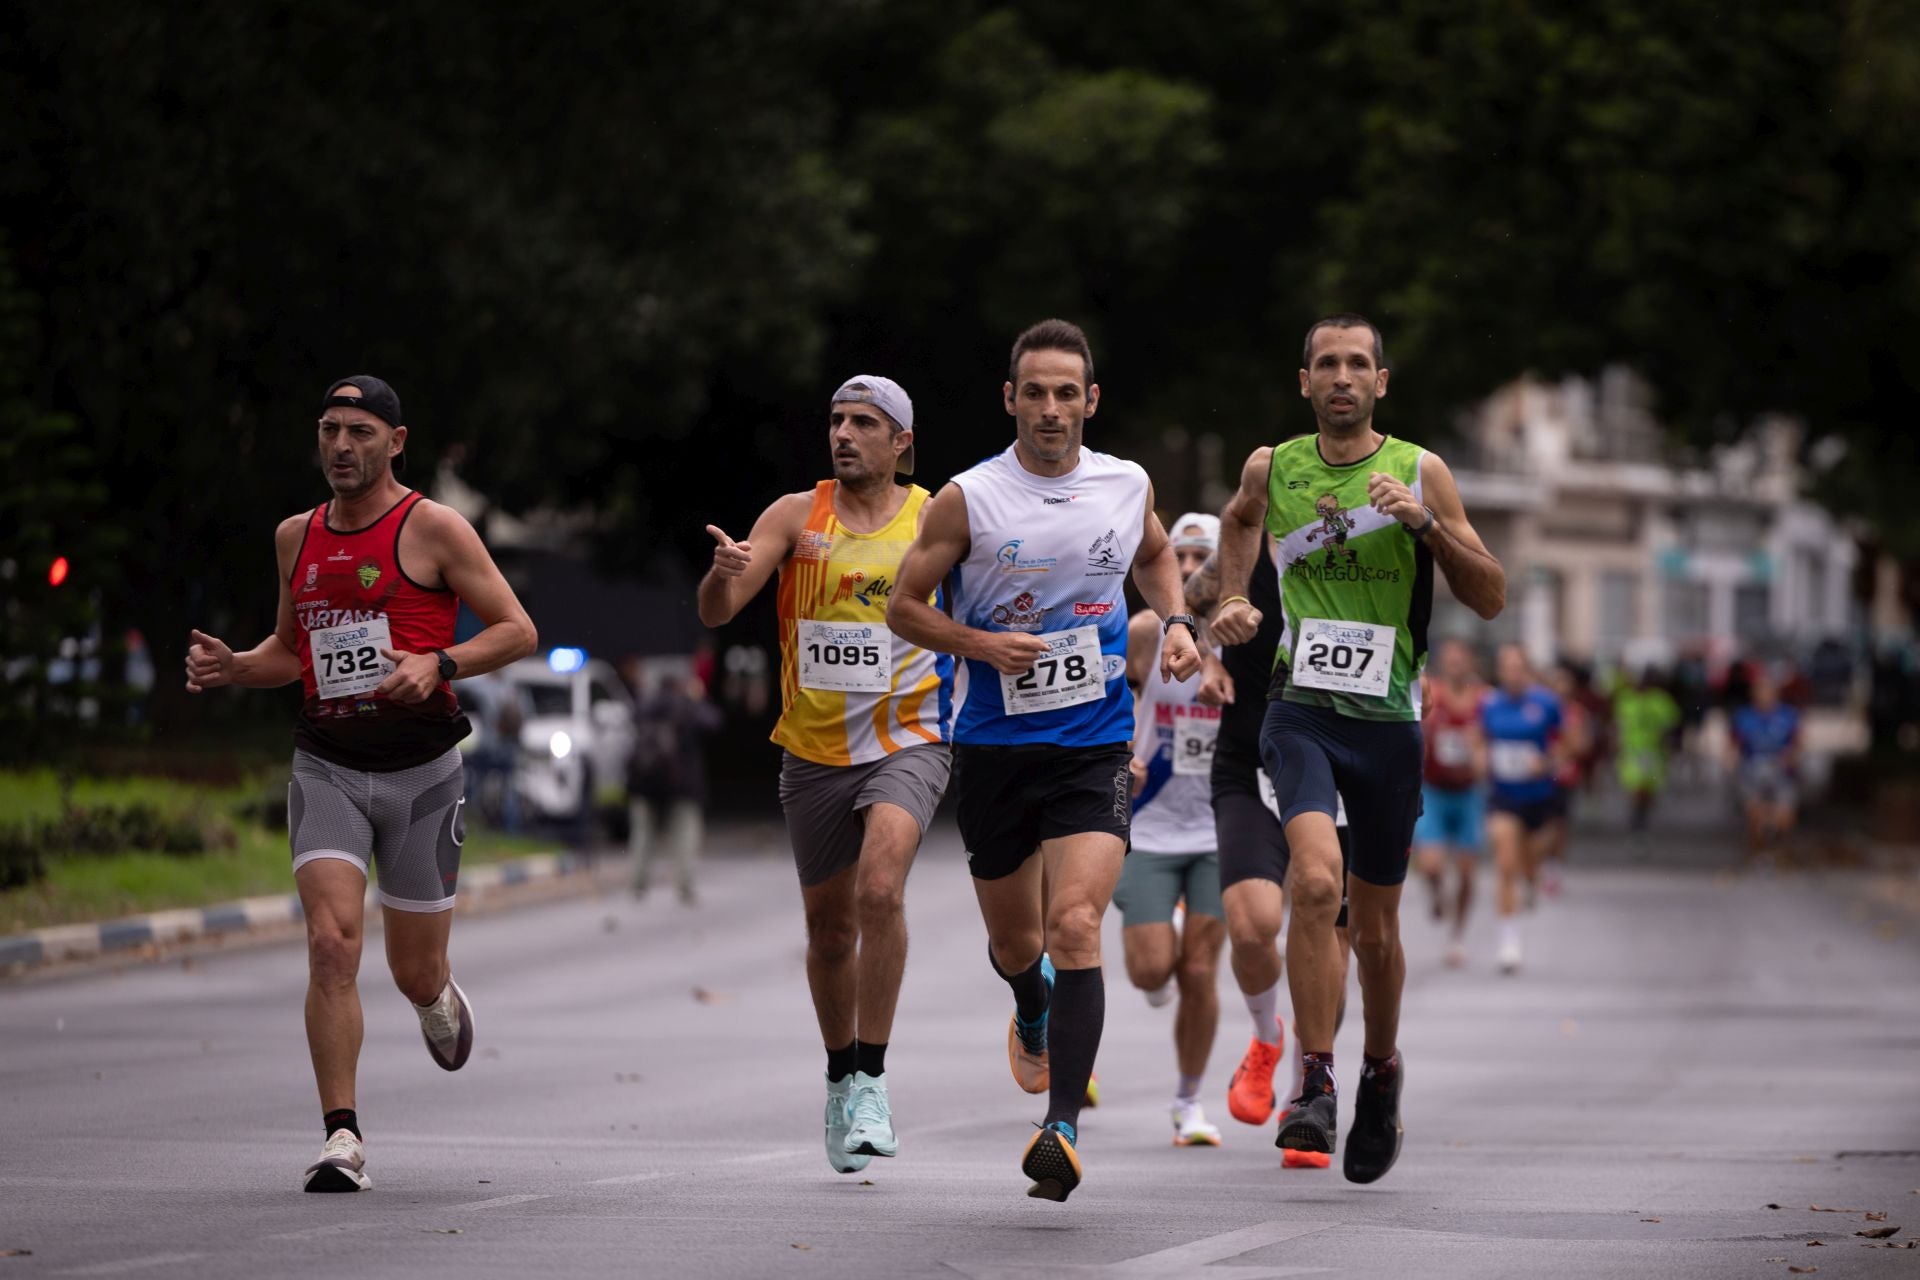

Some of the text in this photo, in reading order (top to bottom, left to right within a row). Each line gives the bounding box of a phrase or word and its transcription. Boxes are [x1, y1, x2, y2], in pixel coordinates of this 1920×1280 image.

[992, 604, 1053, 625] Quest
[320, 646, 379, 678] 732
[807, 643, 880, 667] 1095
[1308, 643, 1374, 673] 207
[1015, 654, 1088, 691] 278
